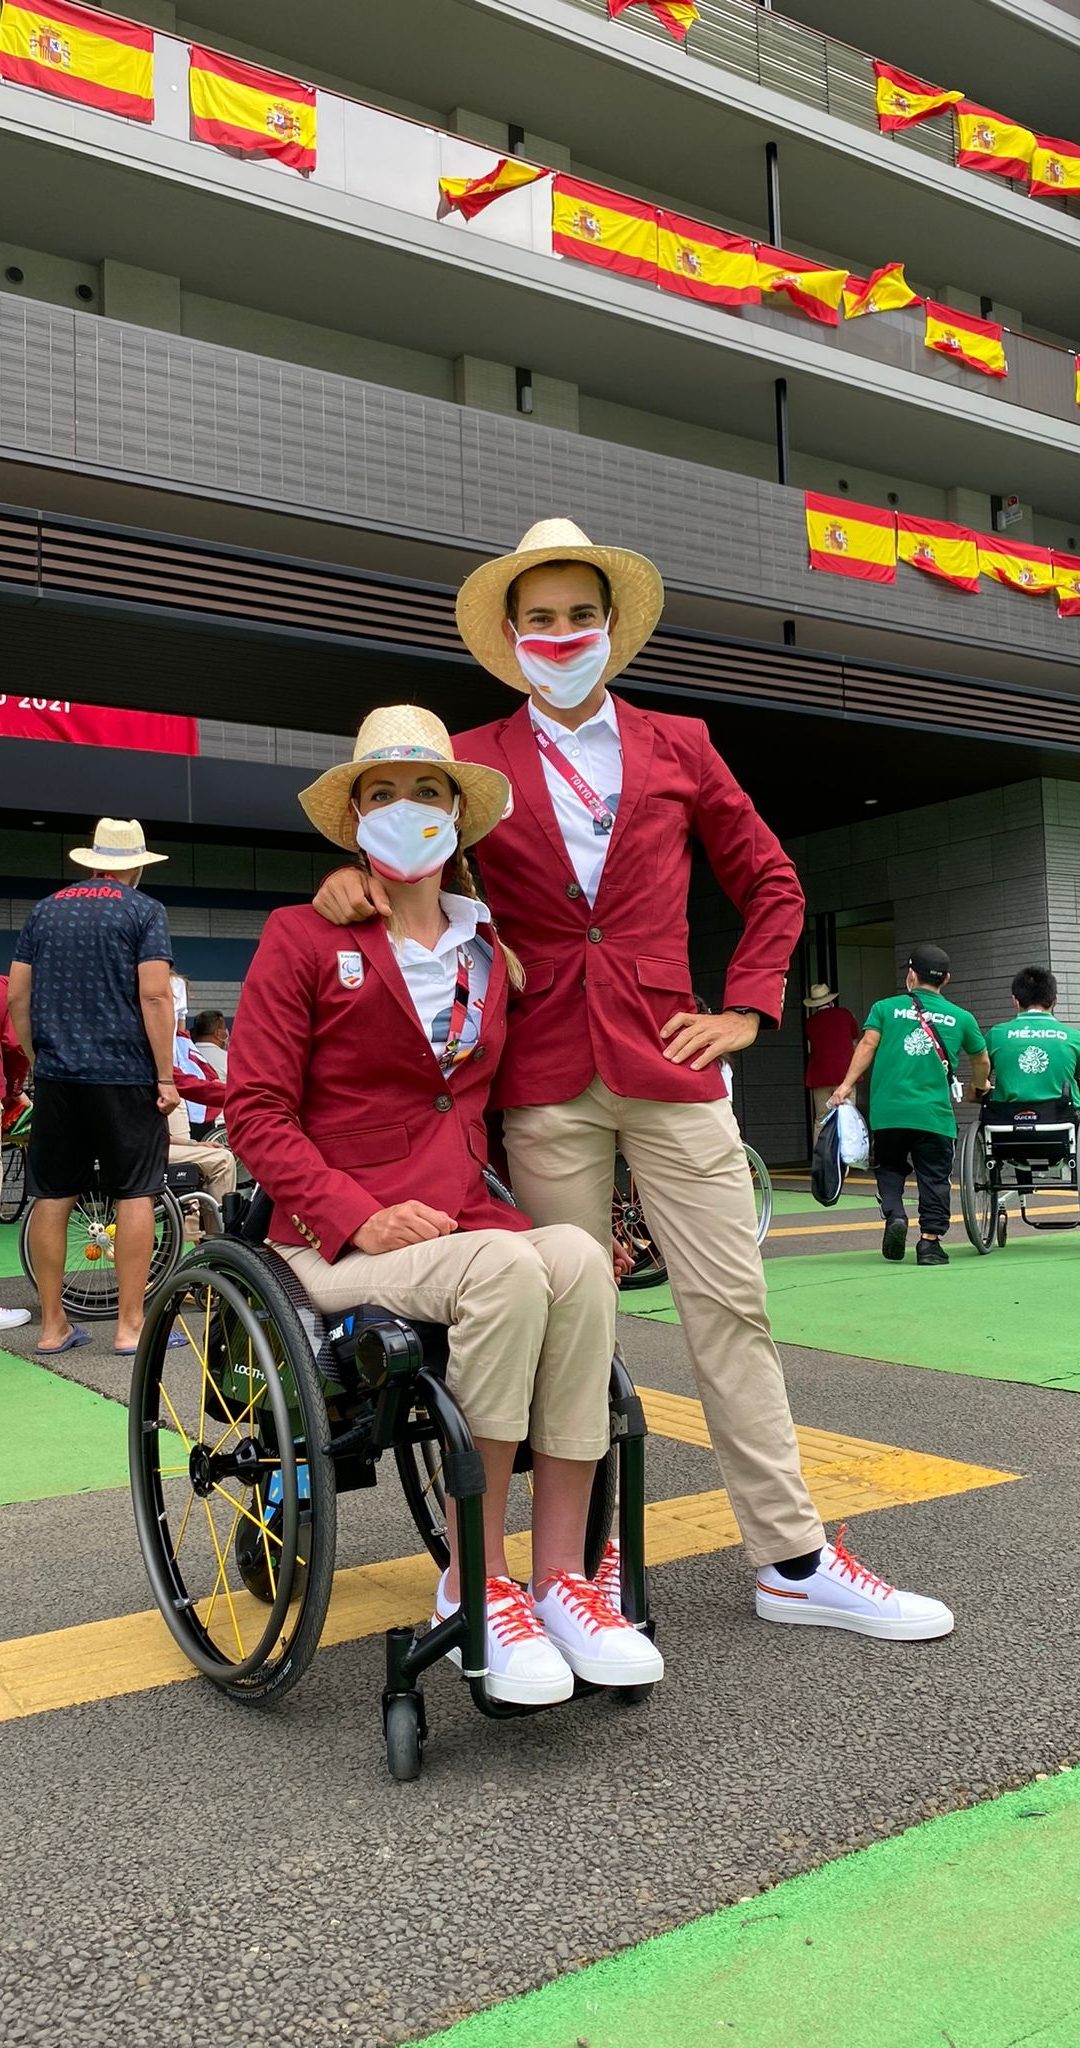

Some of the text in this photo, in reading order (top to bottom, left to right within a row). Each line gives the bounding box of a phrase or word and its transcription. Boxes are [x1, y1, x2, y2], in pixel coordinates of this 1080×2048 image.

[570, 774, 592, 799] TOKYO
[55, 886, 122, 900] ESPAÑA
[1008, 1026, 1067, 1040] MÉXICO
